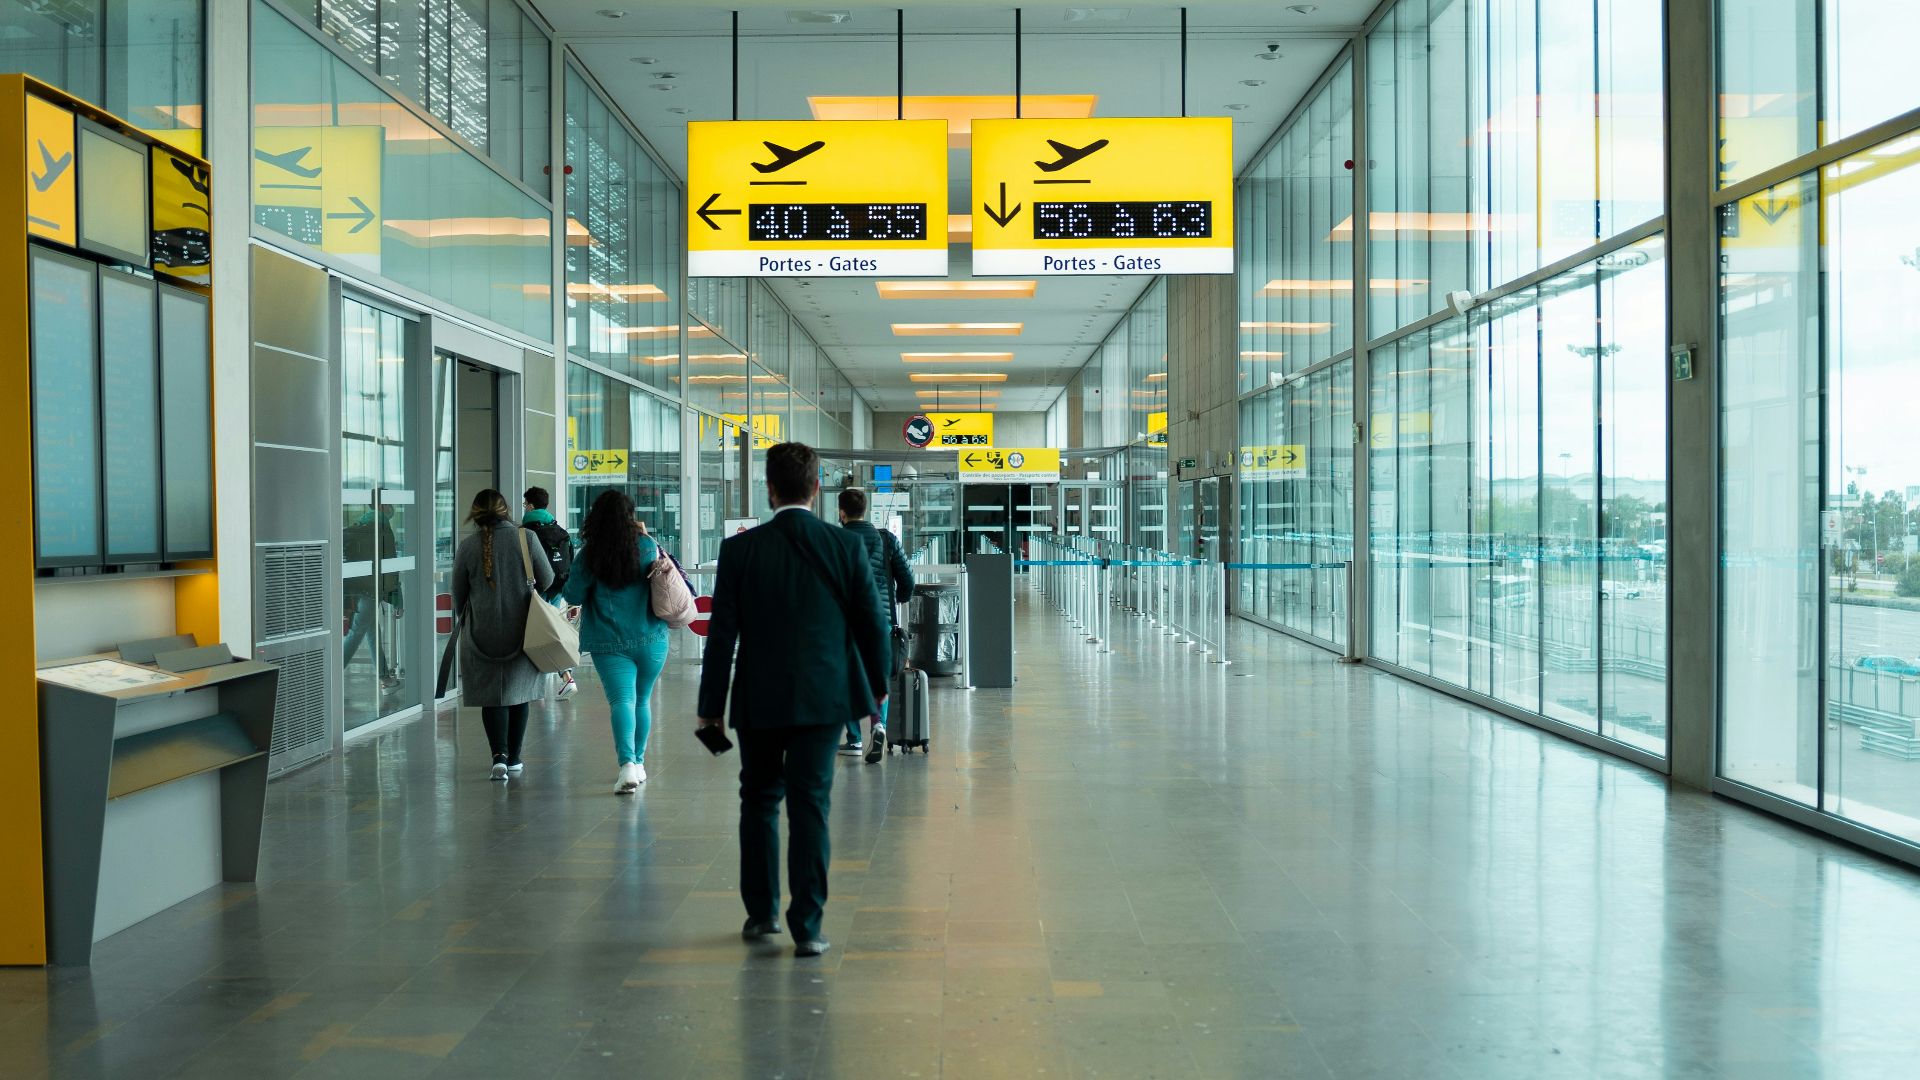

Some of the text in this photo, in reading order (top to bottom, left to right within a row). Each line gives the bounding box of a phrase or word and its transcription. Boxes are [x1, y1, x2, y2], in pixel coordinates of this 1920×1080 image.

[756, 205, 920, 239] 40 à 55
[1040, 203, 1205, 238] 56 à 63
[759, 257, 812, 272] Portes
[829, 256, 877, 271] Gates
[1044, 256, 1096, 271] Portes
[1113, 255, 1162, 270] Gates
[942, 435, 958, 444] 56
[971, 435, 987, 444] 63
